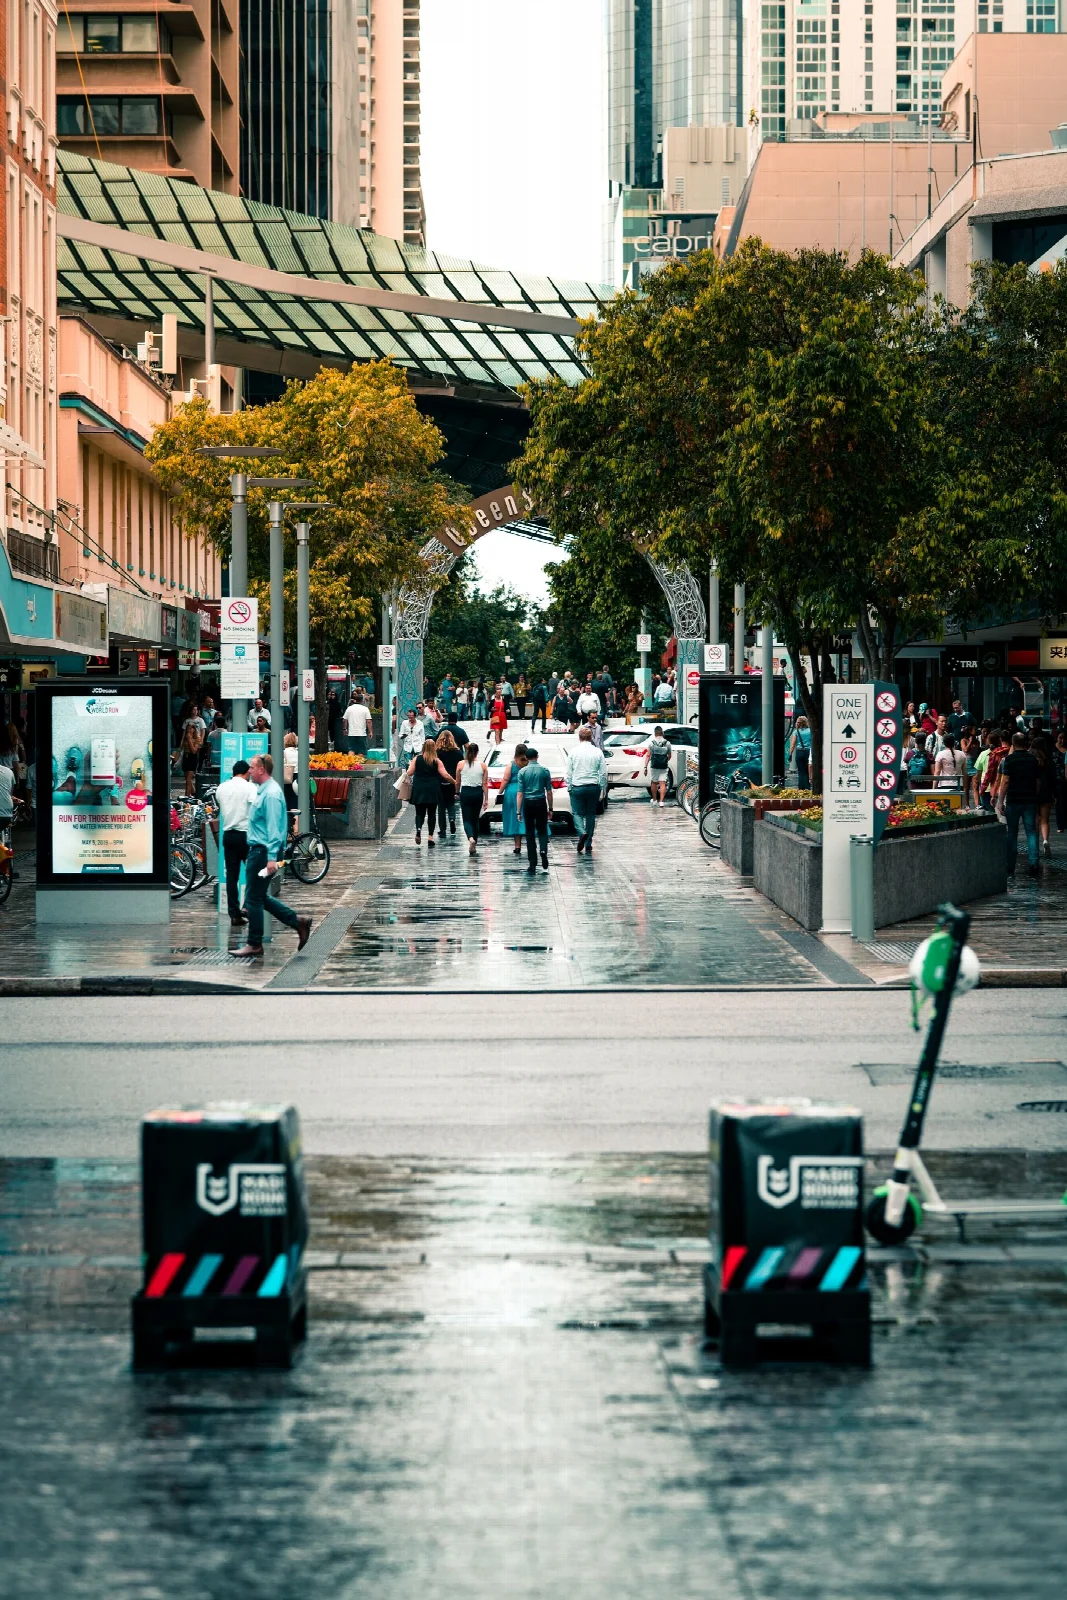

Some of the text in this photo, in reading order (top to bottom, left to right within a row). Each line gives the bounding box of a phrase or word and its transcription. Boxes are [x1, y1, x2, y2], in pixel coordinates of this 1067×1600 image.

[634, 231, 712, 257] capri
[718, 694, 748, 704] THE 8
[836, 698, 862, 708] ONE
[836, 710, 862, 720] WAY
[844, 751, 854, 759] 10
[58, 814, 147, 823] RUN FOR THOSE WHO CAN'T
